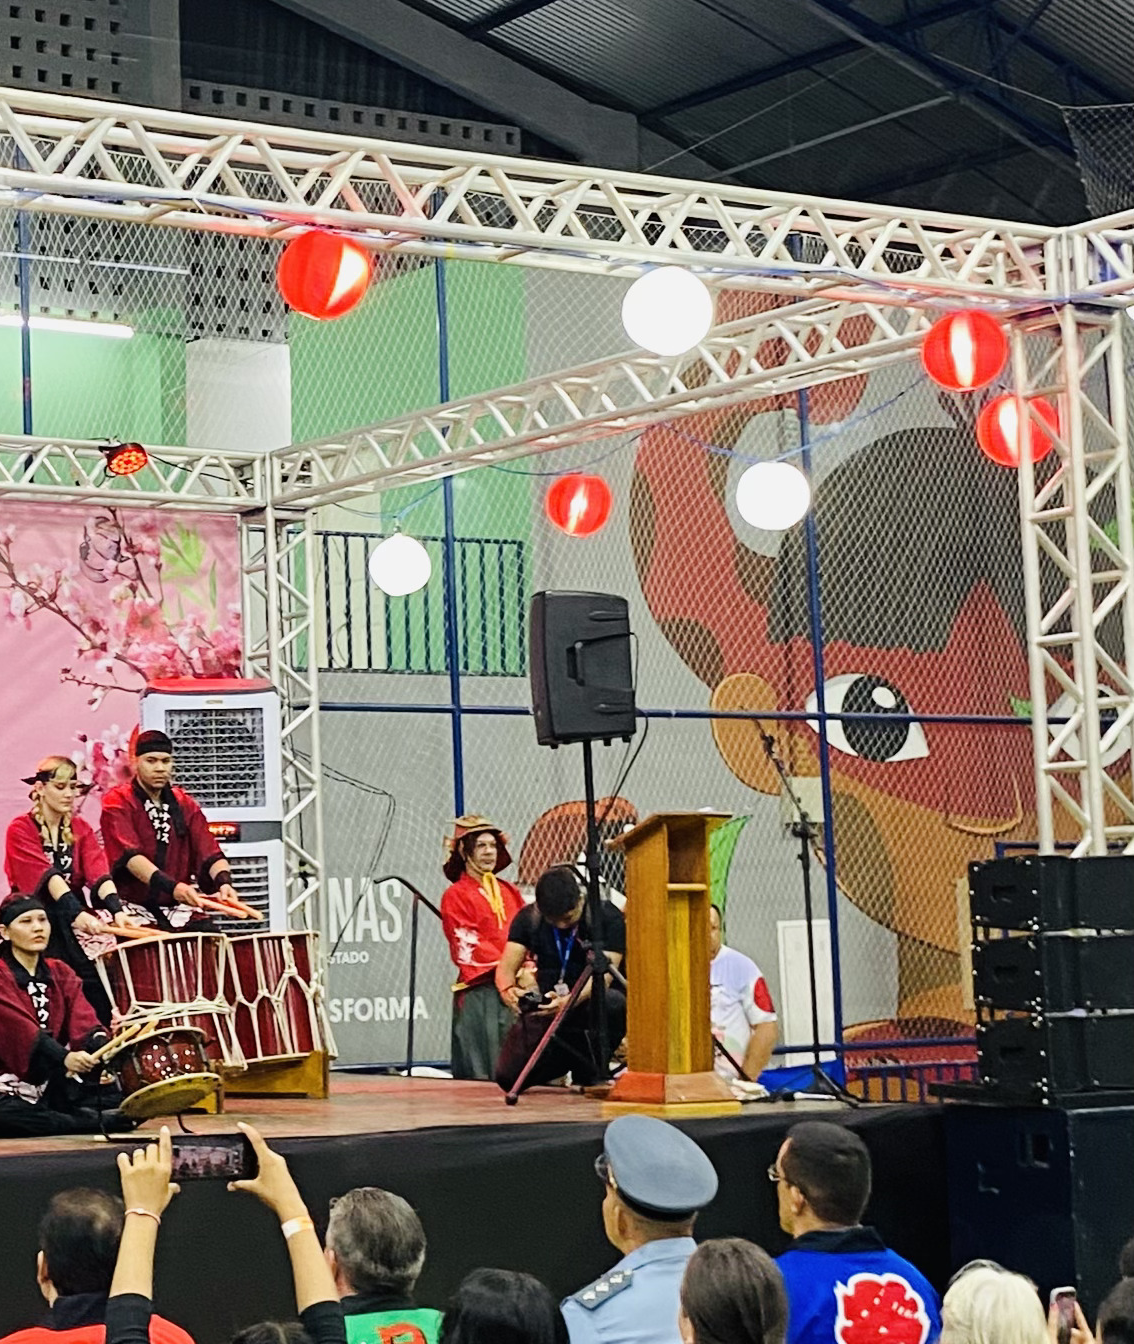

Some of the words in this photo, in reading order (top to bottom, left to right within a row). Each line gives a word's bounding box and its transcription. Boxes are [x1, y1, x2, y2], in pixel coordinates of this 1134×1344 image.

[327, 877, 403, 943] NAS
[327, 950, 369, 965] STADO
[329, 995, 429, 1023] SFORMA
